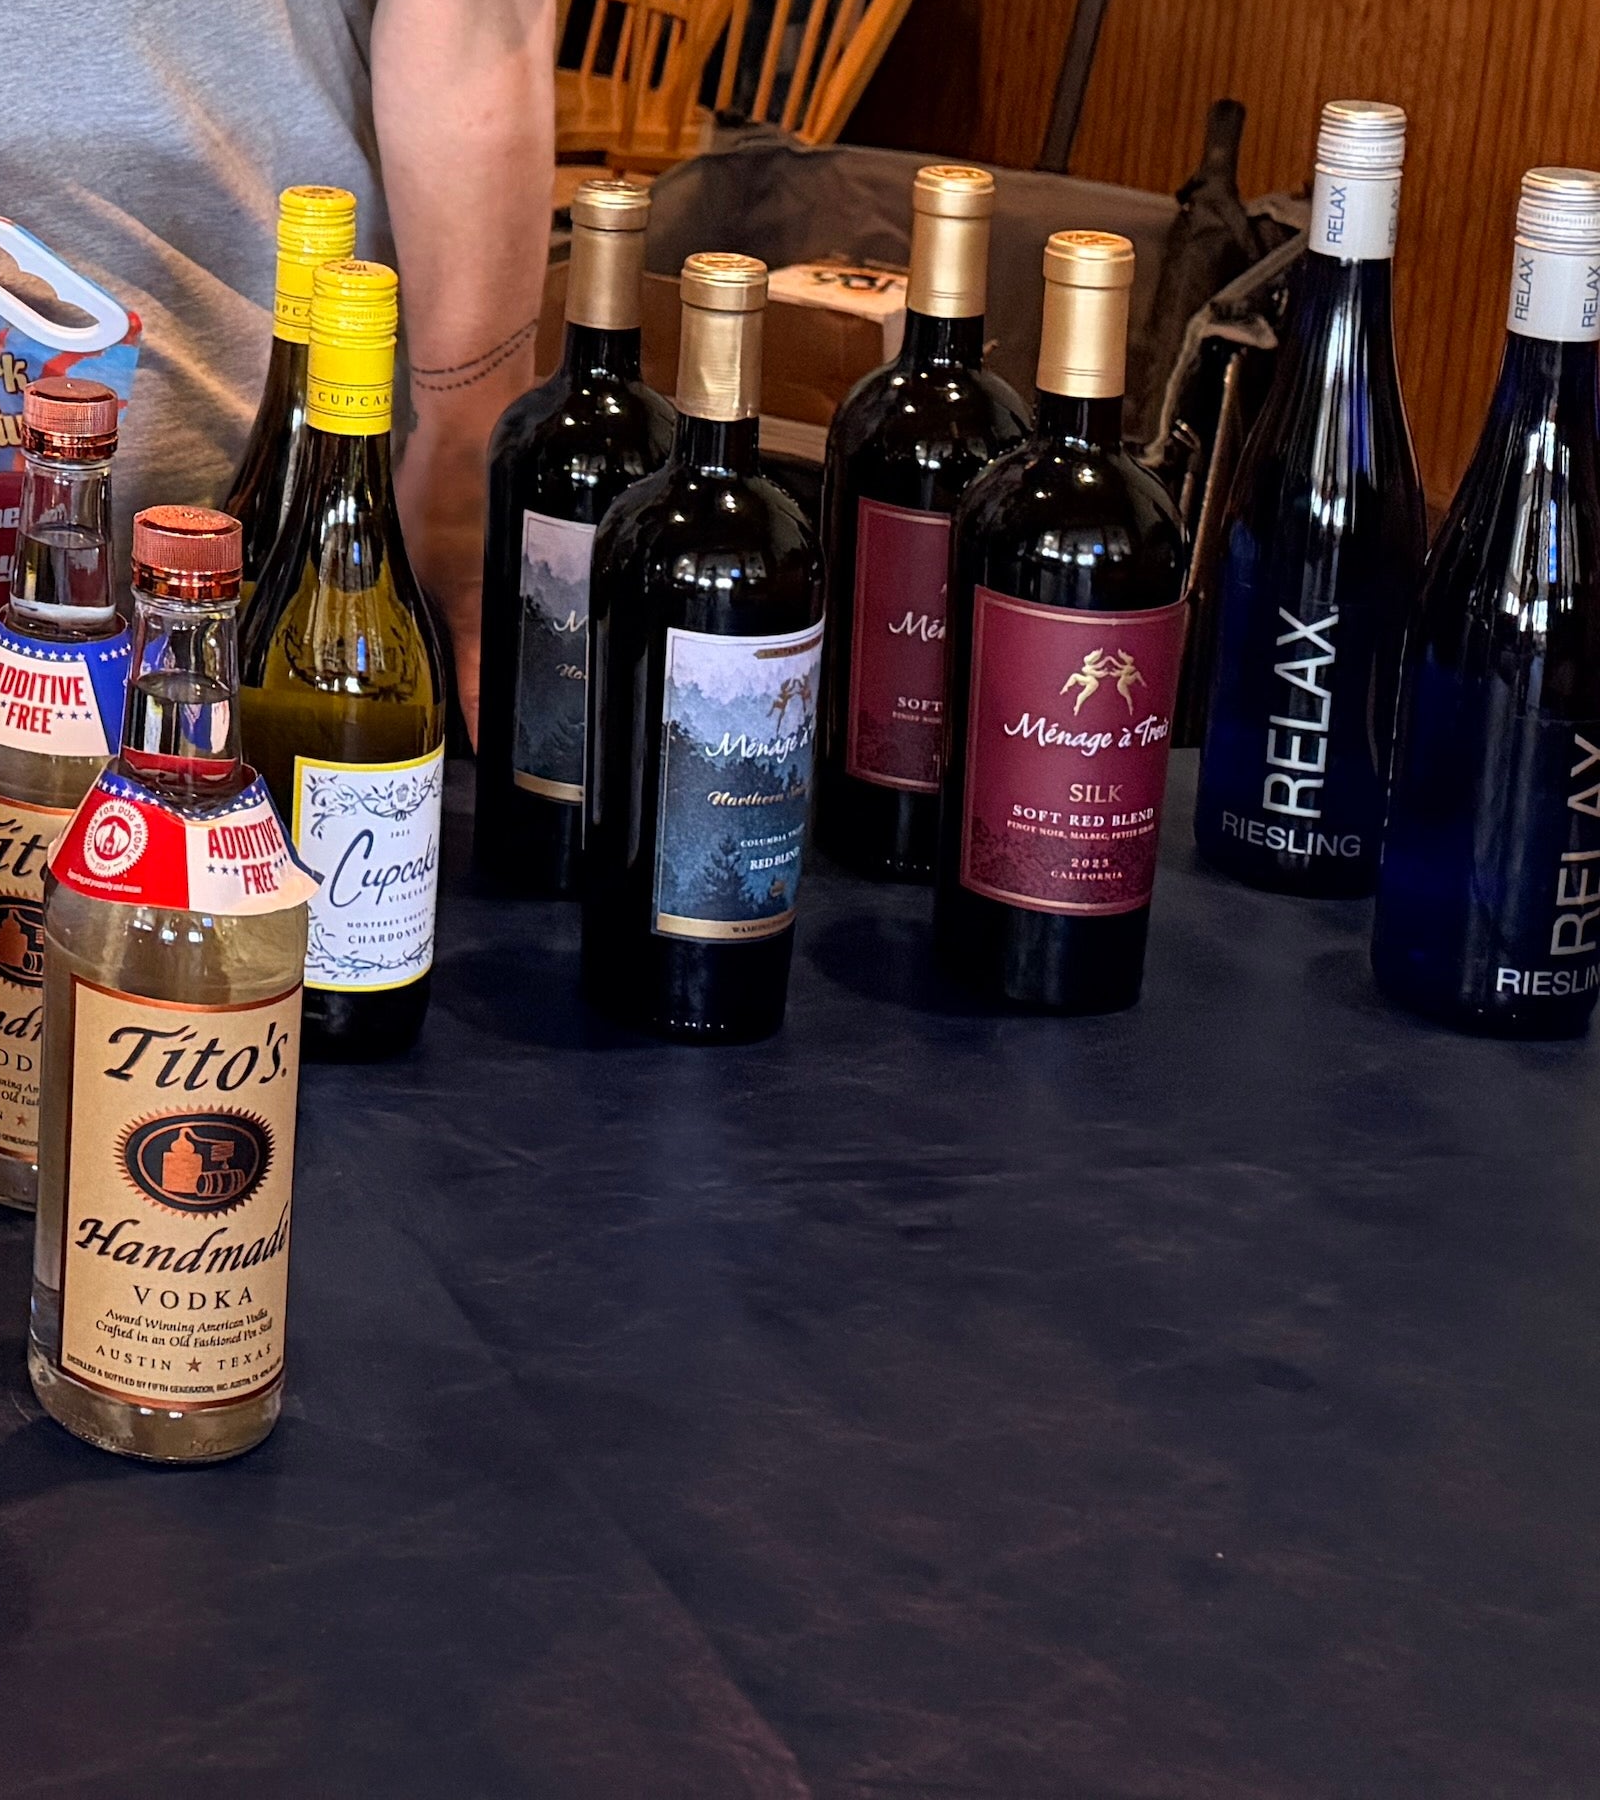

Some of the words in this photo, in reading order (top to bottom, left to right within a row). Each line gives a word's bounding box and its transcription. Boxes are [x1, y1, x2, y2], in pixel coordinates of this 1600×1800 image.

[1325, 185, 1348, 244] RELAX
[1514, 257, 1535, 321] RELAX
[1581, 266, 1600, 328] RELAX
[5, 701, 53, 736] FREE
[897, 696, 944, 712] SOFT
[1262, 604, 1340, 819] RELAX
[705, 731, 798, 764] Ménage
[1003, 712, 1113, 757] Ménage
[1118, 727, 1132, 749] à
[1069, 783, 1124, 804] SILK
[117, 804, 137, 823] DOG
[1006, 819, 1038, 834] PINOT
[1012, 804, 1062, 825] SOFT
[1069, 813, 1106, 828] RED
[1111, 806, 1155, 828] BLEND
[124, 823, 143, 863] PEOPLE
[207, 816, 284, 860] ADDITIVE
[1221, 809, 1362, 858] RIESLING
[242, 861, 280, 896] FREE
[749, 857, 773, 871] RED
[1050, 870, 1124, 882] CALIFORNIA
[1071, 857, 1110, 869] 2023
[103, 1021, 289, 1092] Tito's
[133, 1285, 253, 1311] VODKA
[95, 1319, 134, 1339] Crafted
[136, 1330, 148, 1343] in
[151, 1336, 166, 1346] an
[169, 1333, 190, 1348] Old
[105, 1308, 143, 1327] Award
[144, 1317, 195, 1335] Winning
[197, 1319, 244, 1334] American
[96, 1344, 173, 1372] AUSTIN
[217, 1342, 272, 1371] TEXAS
